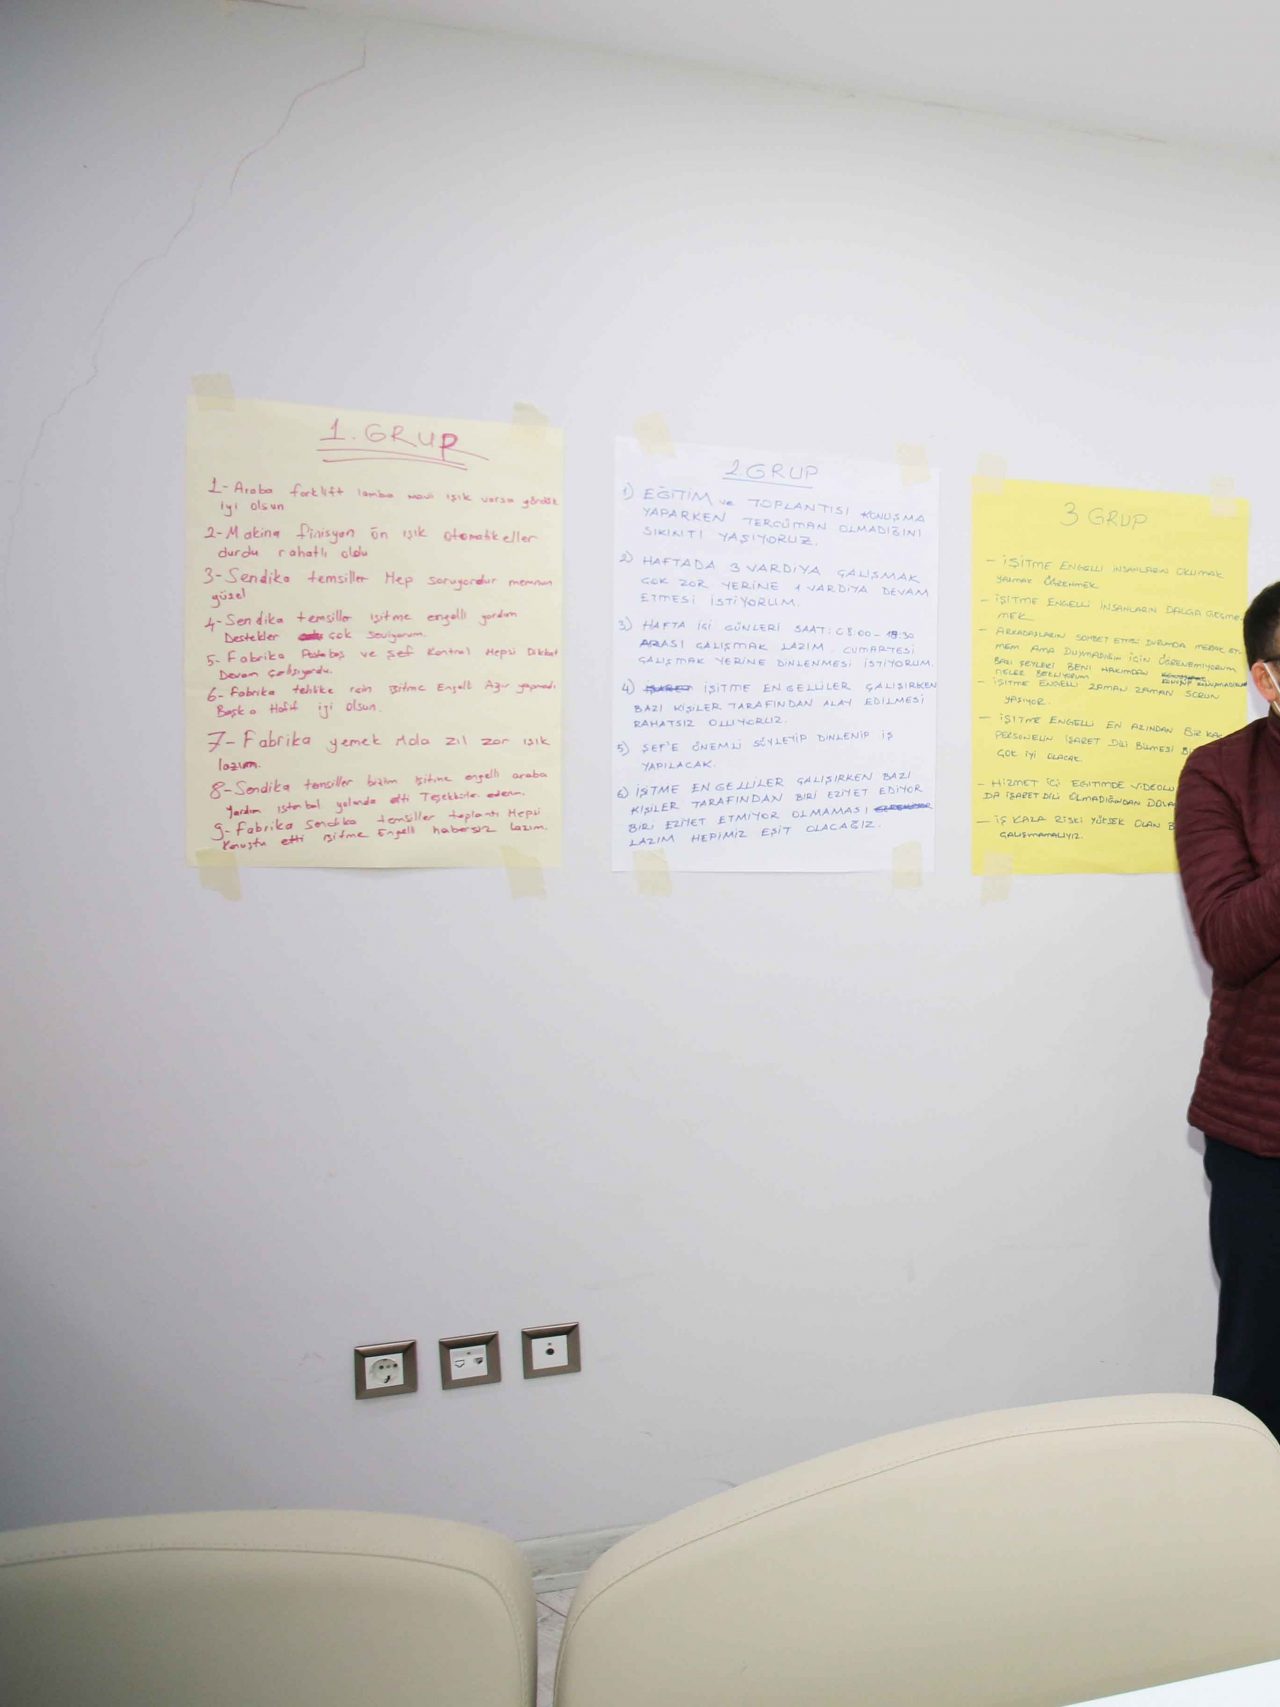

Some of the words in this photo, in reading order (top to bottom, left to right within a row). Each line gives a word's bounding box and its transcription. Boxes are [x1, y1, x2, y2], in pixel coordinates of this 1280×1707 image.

[364, 423, 463, 462] GRUP
[724, 458, 740, 475] 2
[745, 463, 819, 481] GRUP
[250, 500, 284, 511] olsun
[642, 506, 727, 522] YAPARKEN
[1059, 501, 1079, 526] 3
[1088, 506, 1148, 530] GRUP
[218, 544, 259, 558] durdu
[642, 556, 716, 570] HAFTADA
[730, 562, 740, 573] 3
[385, 571, 414, 588] Hep
[210, 588, 246, 608] güzel
[881, 586, 929, 597] DEVAM
[642, 619, 686, 630] HAFTA
[639, 638, 684, 649] ARASI
[780, 642, 824, 652] LAZIM
[227, 650, 285, 663] Fabrika
[823, 699, 852, 707] ALAY
[1106, 720, 1122, 730] EN
[243, 729, 312, 748] Fabrika
[326, 733, 382, 753] yemek
